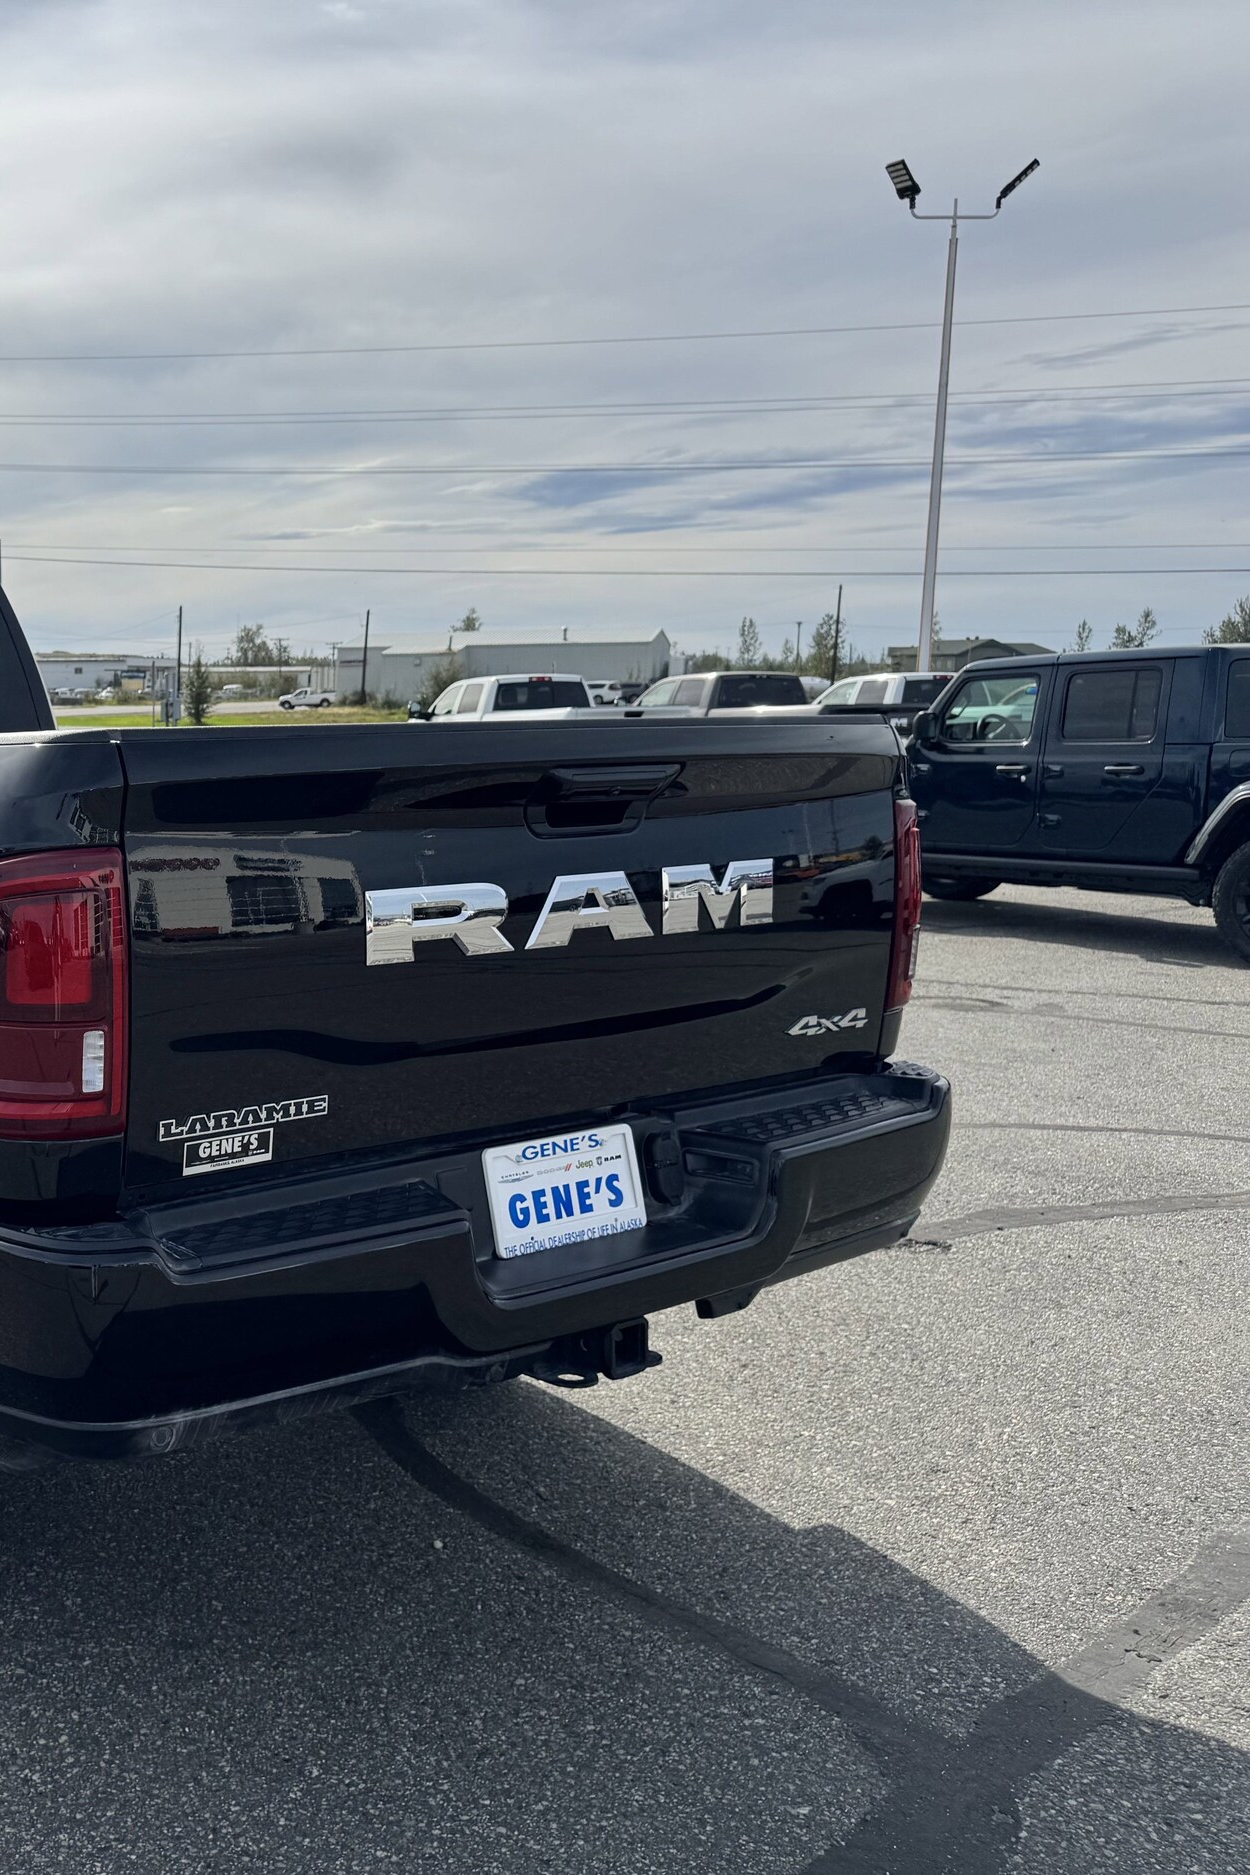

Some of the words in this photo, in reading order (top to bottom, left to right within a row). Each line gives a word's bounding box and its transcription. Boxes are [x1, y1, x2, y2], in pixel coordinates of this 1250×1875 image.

[364, 858, 774, 967] RAM
[158, 1094, 329, 1142] LARAMIE
[198, 1133, 259, 1159] GENE'S
[521, 1133, 600, 1161] GENE'S
[575, 1159, 594, 1170] Jeep
[603, 1154, 622, 1162] RAM
[508, 1173, 624, 1229] GENE'S
[504, 1245, 518, 1258] THE
[520, 1238, 547, 1255] OFFICIAL
[548, 1229, 586, 1248] DEALERSHIP
[586, 1227, 596, 1240] OF
[597, 1224, 610, 1237] LIFE
[610, 1222, 618, 1235] IN
[619, 1217, 643, 1234] ALASKA
